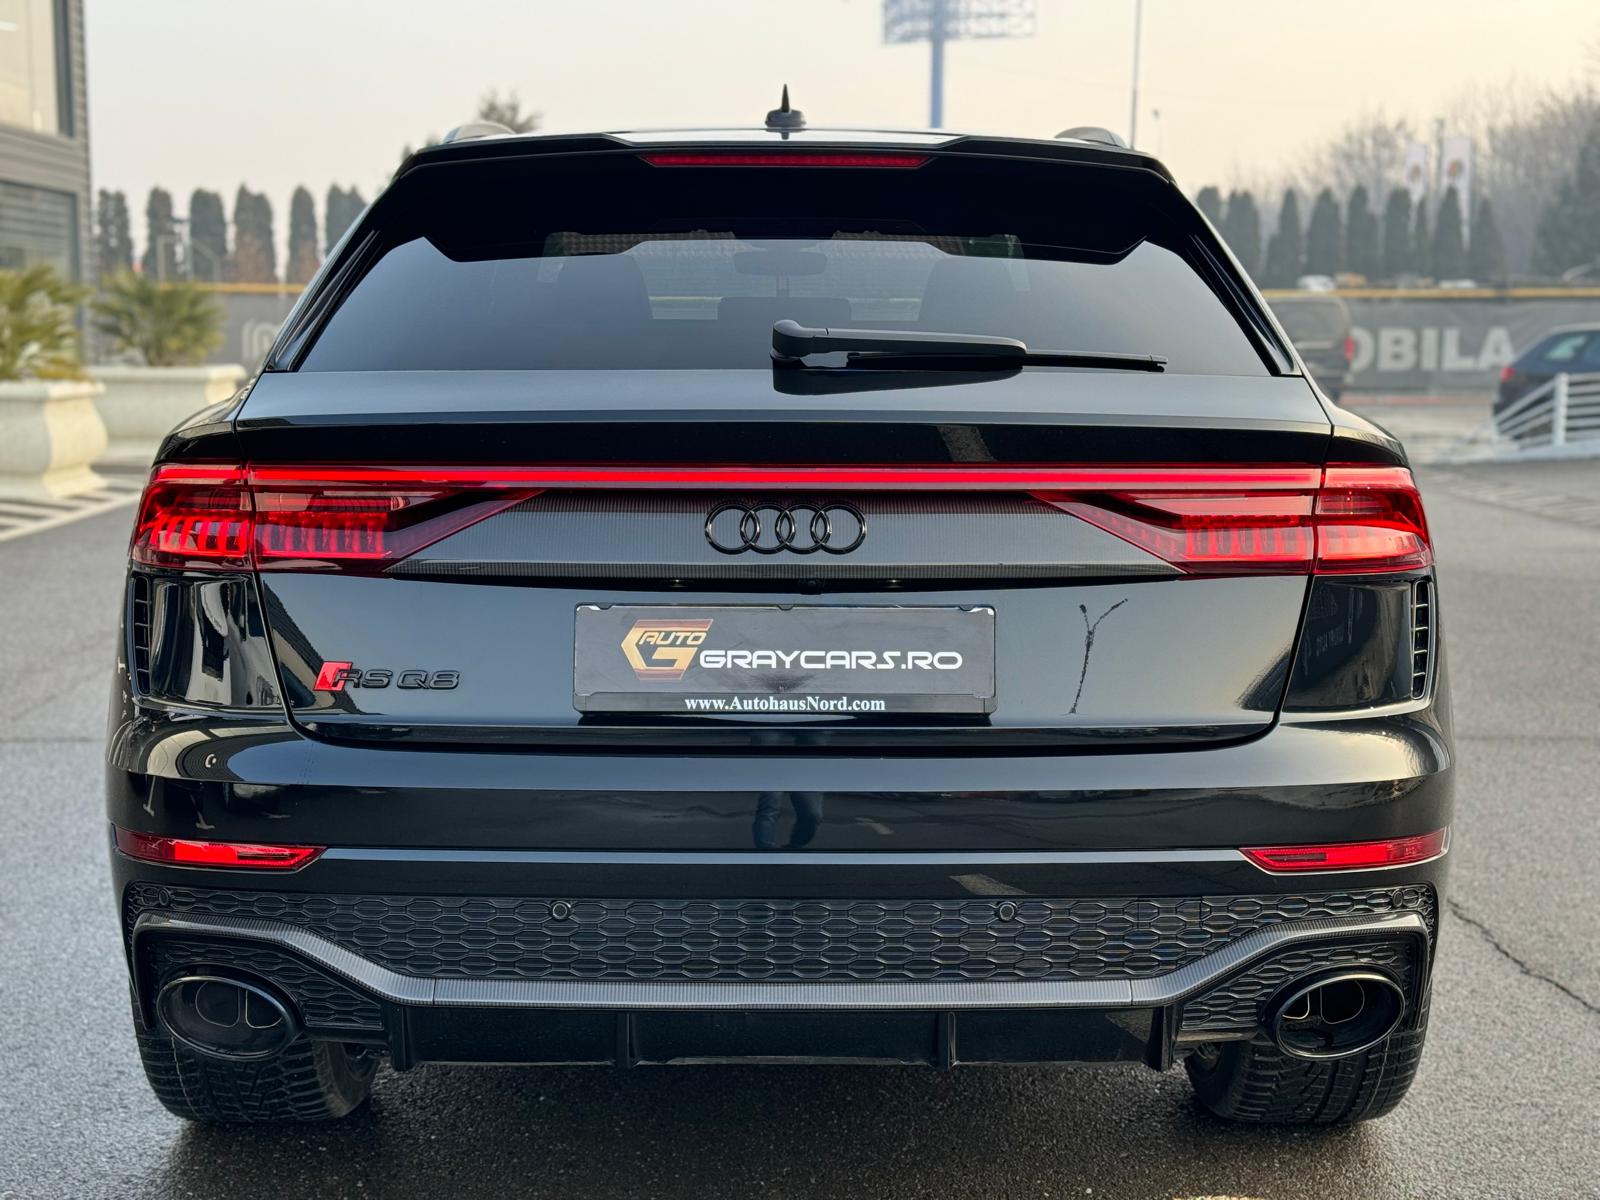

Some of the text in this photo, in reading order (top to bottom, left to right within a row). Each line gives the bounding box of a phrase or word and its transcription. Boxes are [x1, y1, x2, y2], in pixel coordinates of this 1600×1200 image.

[639, 631, 707, 645] AUTO
[699, 649, 963, 670] GRAYCARS.RO
[684, 696, 886, 711] www.AutohausNord.com
